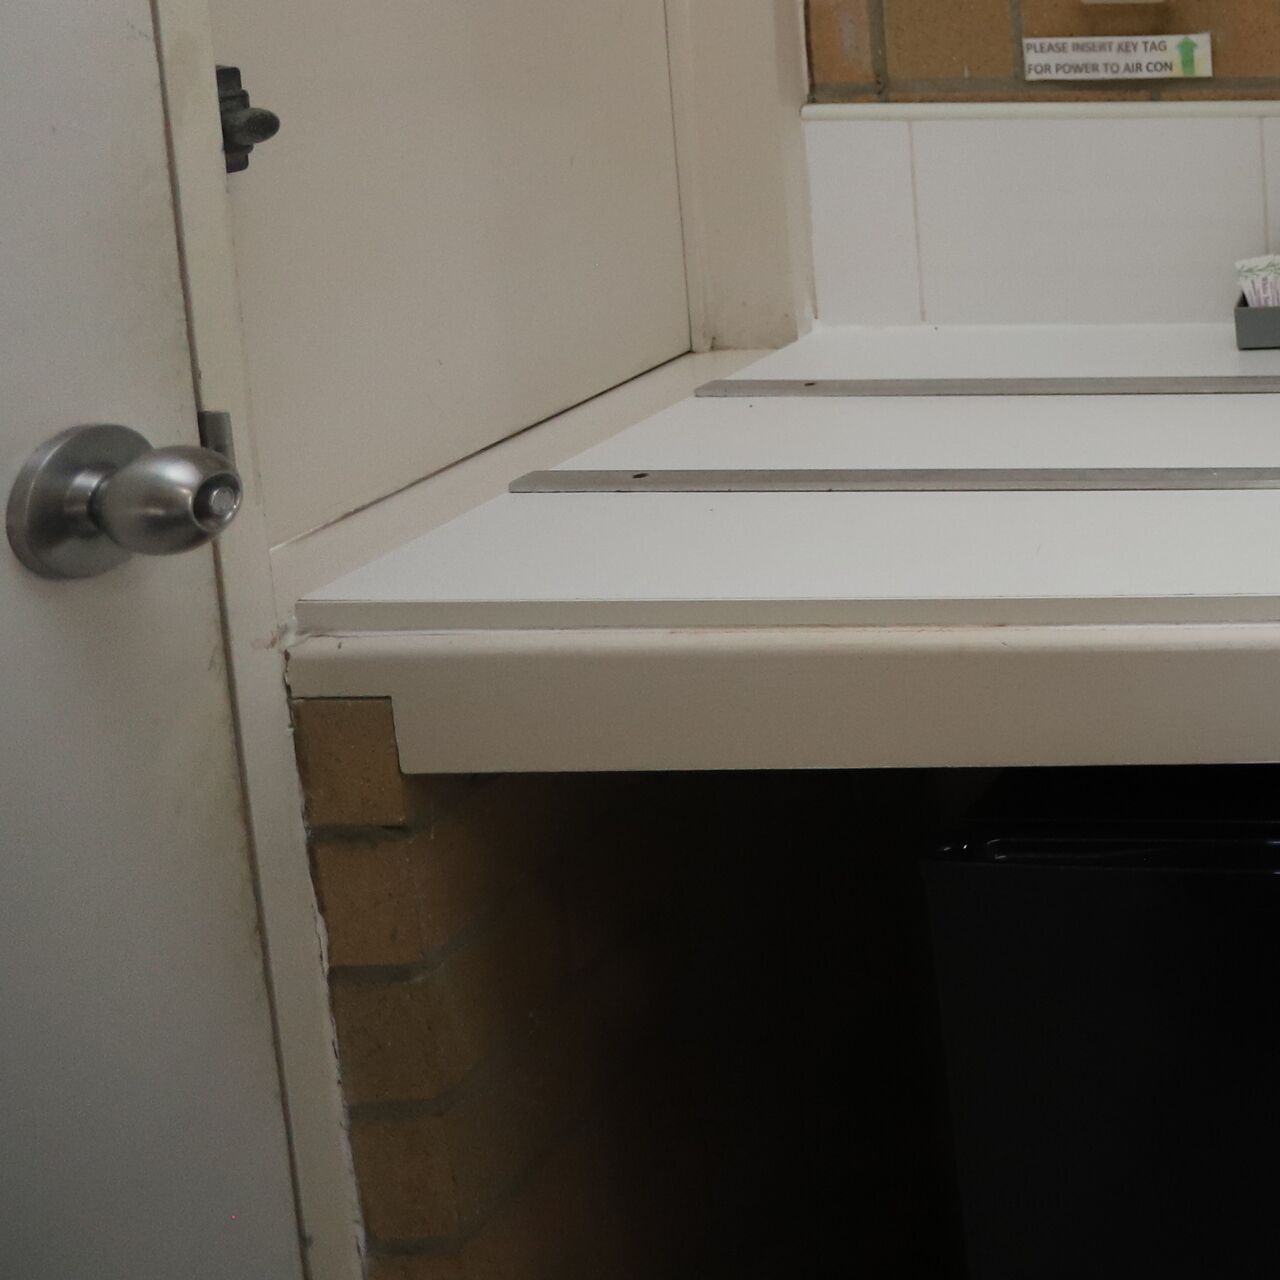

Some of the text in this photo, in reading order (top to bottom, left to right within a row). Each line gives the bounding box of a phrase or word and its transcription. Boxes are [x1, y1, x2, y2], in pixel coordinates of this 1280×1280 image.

[1026, 40, 1167, 54] PLEASE INSERT KEY TAG
[1027, 61, 1173, 76] FOR POWER TO AIR CON
